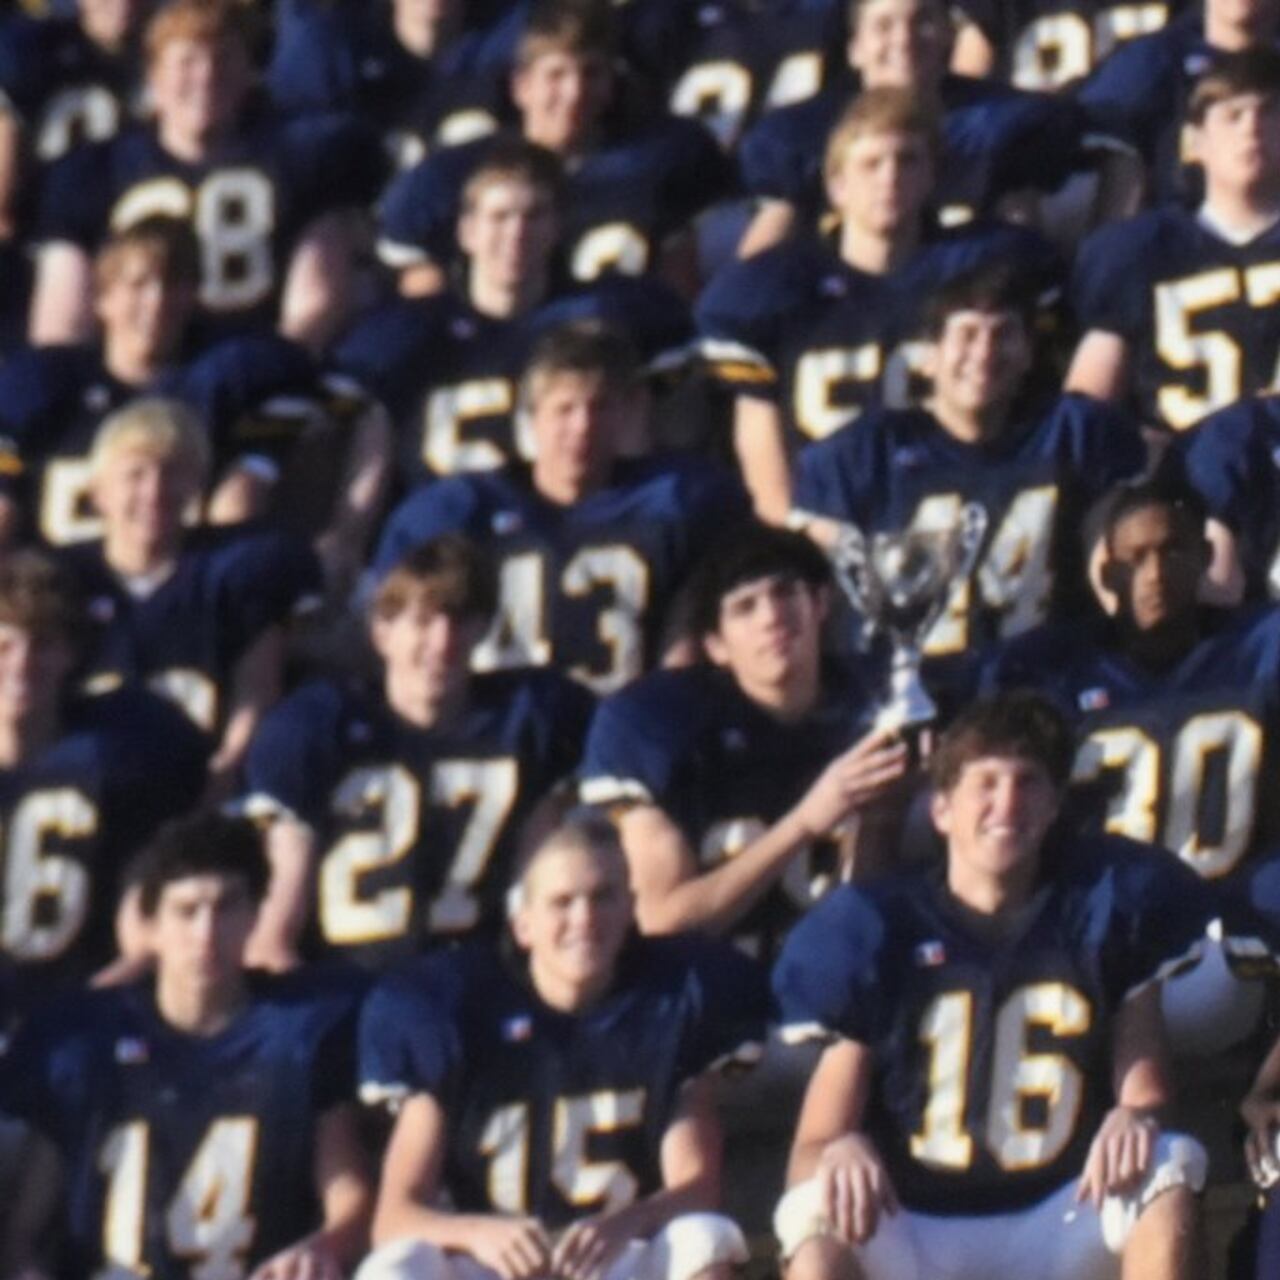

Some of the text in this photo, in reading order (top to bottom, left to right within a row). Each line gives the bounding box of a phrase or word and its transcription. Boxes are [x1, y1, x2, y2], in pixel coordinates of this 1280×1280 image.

[320, 756, 519, 946] 27
[1071, 709, 1263, 880] 30
[482, 1090, 646, 1217] 15
[911, 982, 1092, 1171] 16
